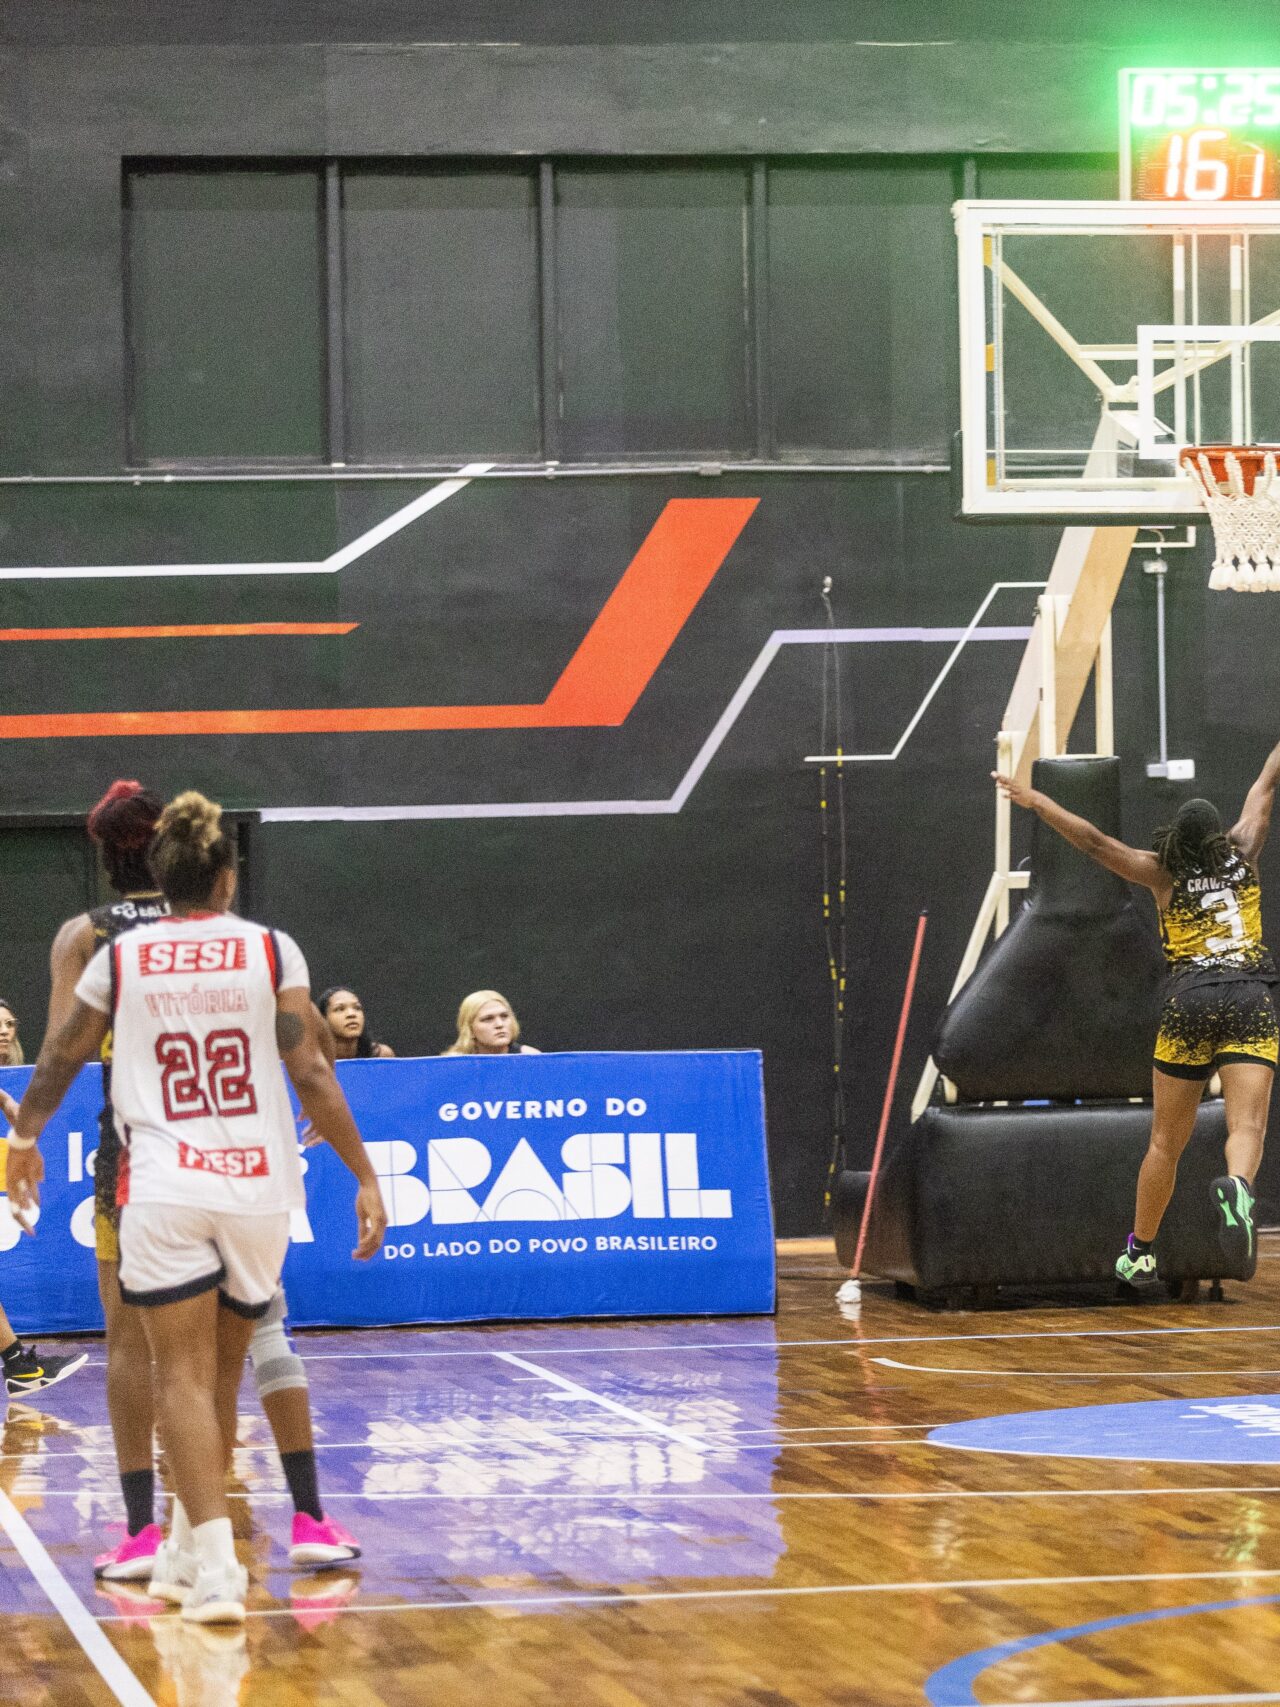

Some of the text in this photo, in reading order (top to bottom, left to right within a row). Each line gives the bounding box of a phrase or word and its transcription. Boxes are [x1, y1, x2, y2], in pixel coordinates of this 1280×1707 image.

[148, 940, 238, 973] SESI
[145, 983, 248, 1017] VITÓRIA
[155, 1028, 258, 1121] 22
[439, 1097, 647, 1122] GOVERNO DO
[362, 1133, 733, 1228] BRASIL
[384, 1235, 718, 1260] DO LADO DO POVO BRASILEIRO
